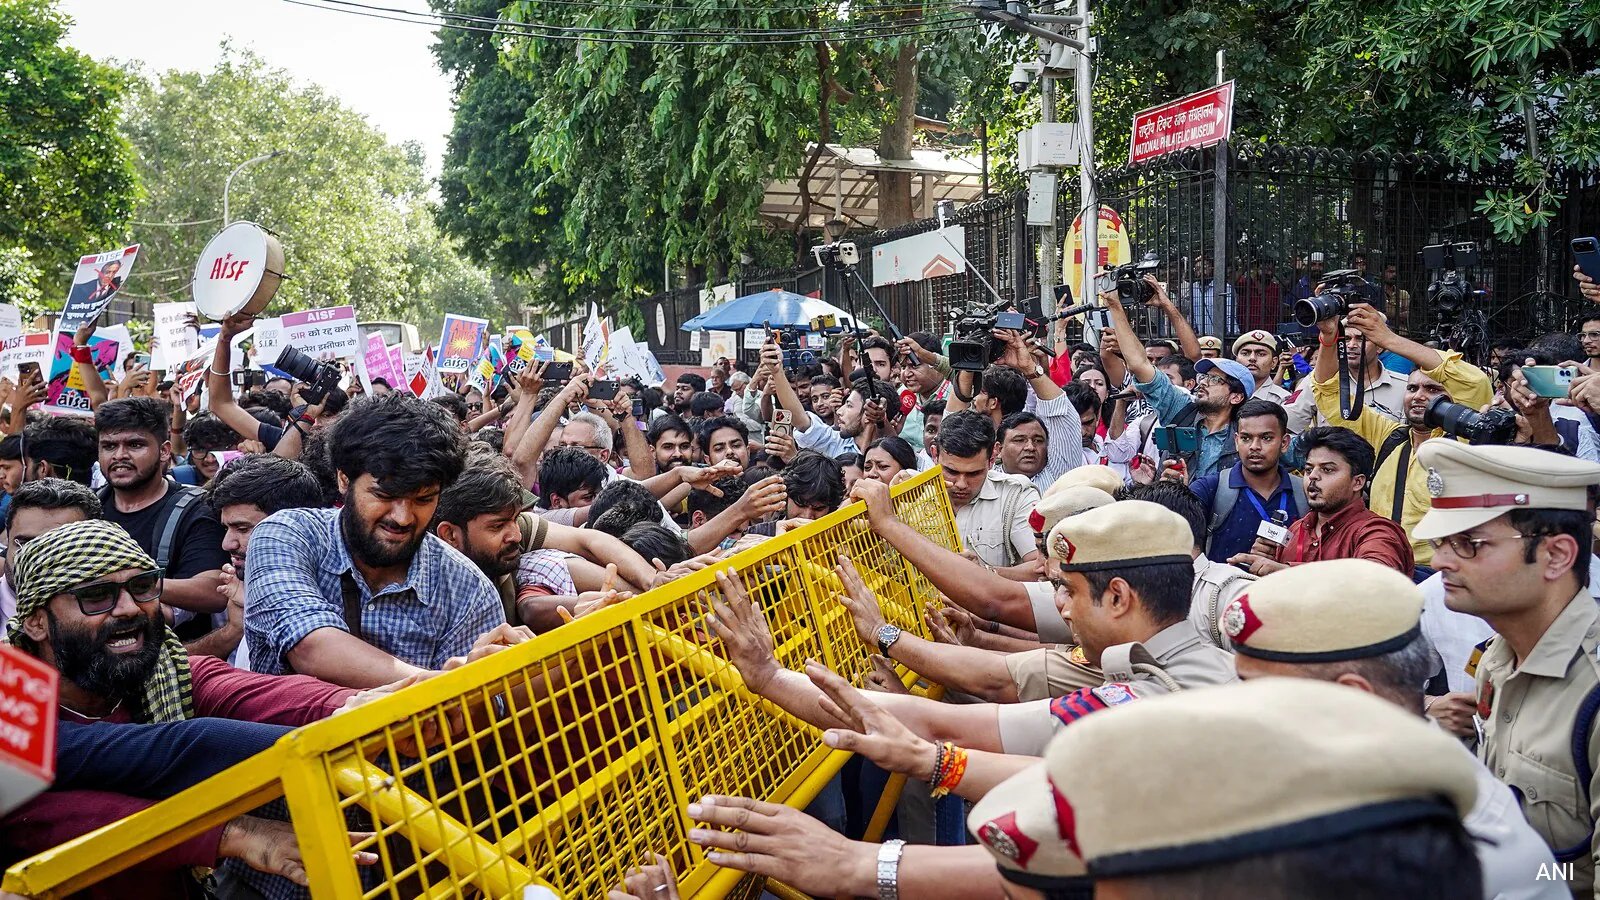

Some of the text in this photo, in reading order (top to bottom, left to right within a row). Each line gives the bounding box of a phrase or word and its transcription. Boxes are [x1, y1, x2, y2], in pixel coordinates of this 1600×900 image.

[1135, 122, 1215, 156] NATIONAL PHILATELIC MUSEUM
[307, 309, 336, 322] AISF
[3, 335, 24, 350] AISF
[290, 331, 305, 340] SIR
[444, 358, 468, 368] aisa
[57, 393, 90, 409] aisa
